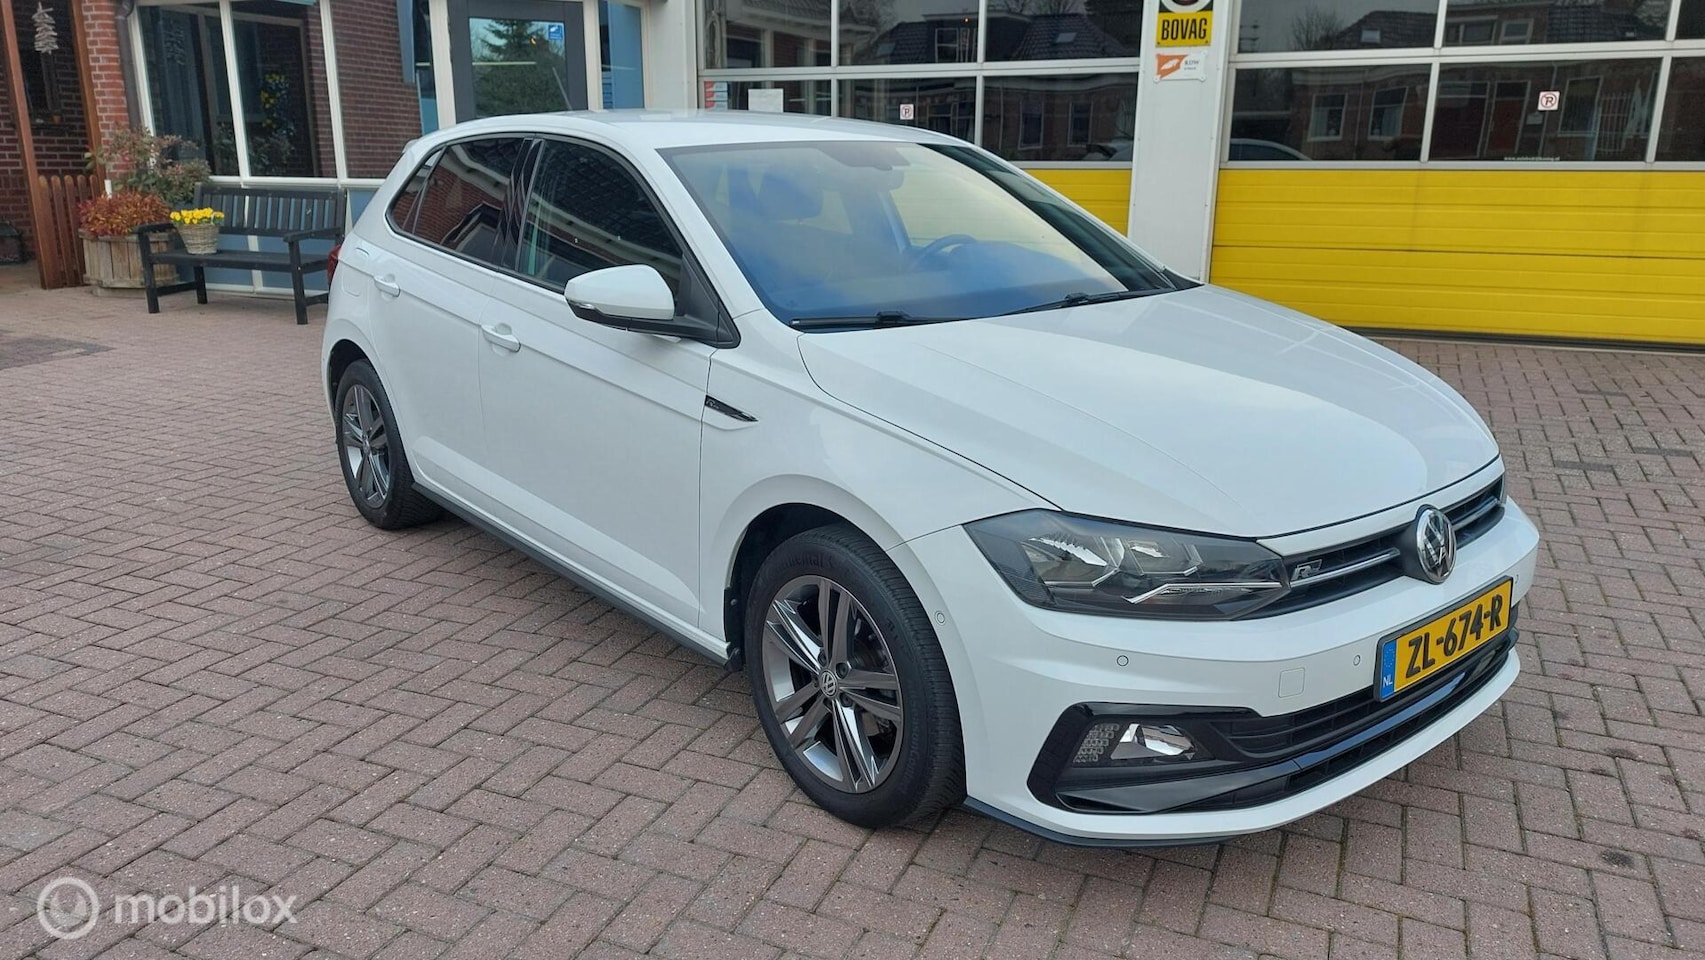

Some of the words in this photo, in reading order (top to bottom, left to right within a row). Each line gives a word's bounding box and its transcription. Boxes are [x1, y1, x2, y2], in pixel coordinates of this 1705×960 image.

[1161, 18, 1208, 40] BOVAG
[1405, 594, 1503, 679] ZL-674-R
[1382, 675, 1393, 688] NL
